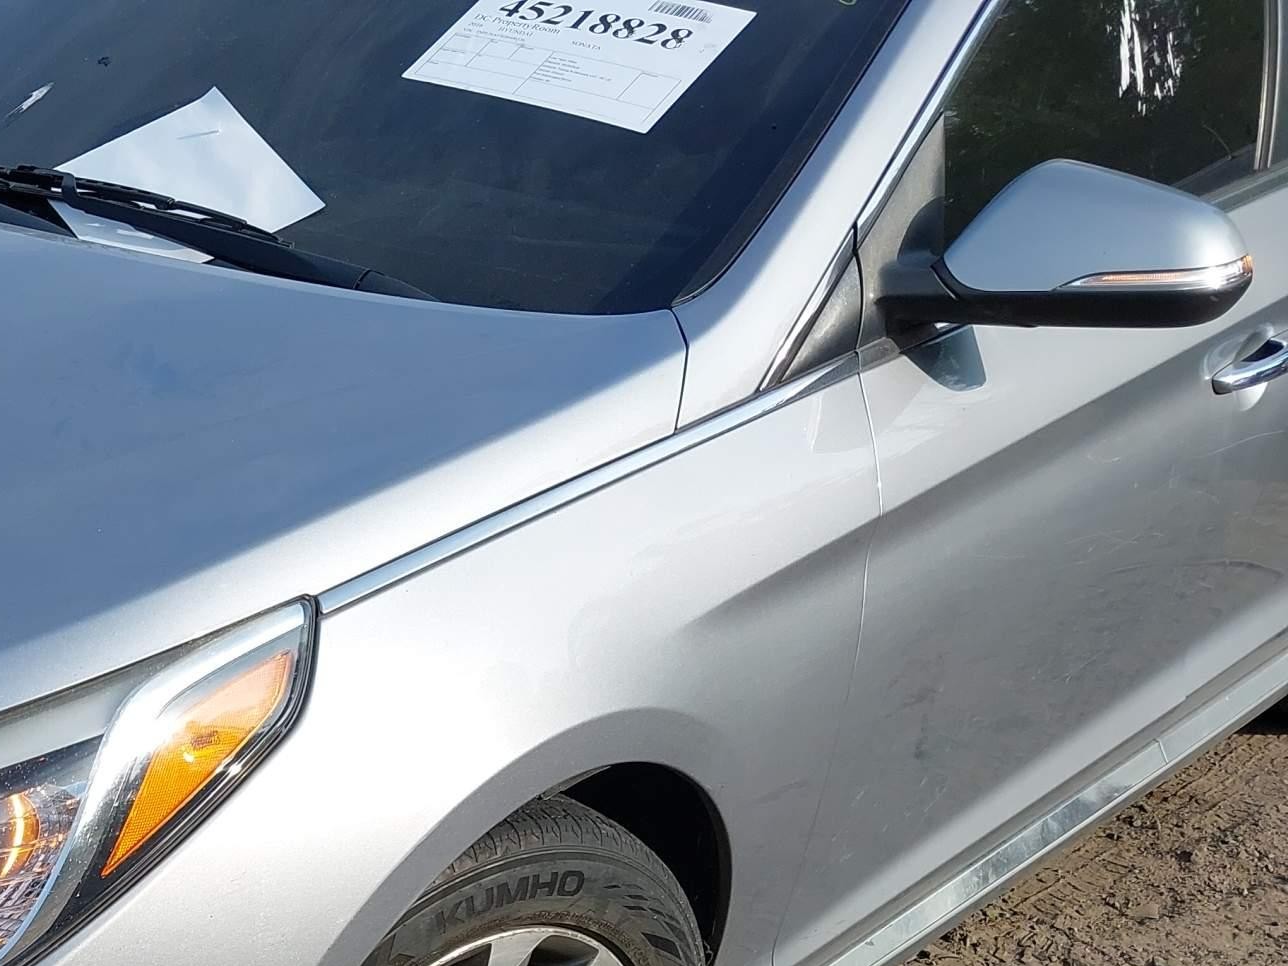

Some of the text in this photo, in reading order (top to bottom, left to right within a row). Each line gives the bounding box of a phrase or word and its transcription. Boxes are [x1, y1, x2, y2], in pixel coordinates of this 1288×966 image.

[492, 16, 532, 30] Property
[532, 23, 561, 35] Room
[497, 26, 534, 37] HYUNDAI
[499, 0, 694, 50] 45218828
[434, 870, 585, 935] KUMHO
